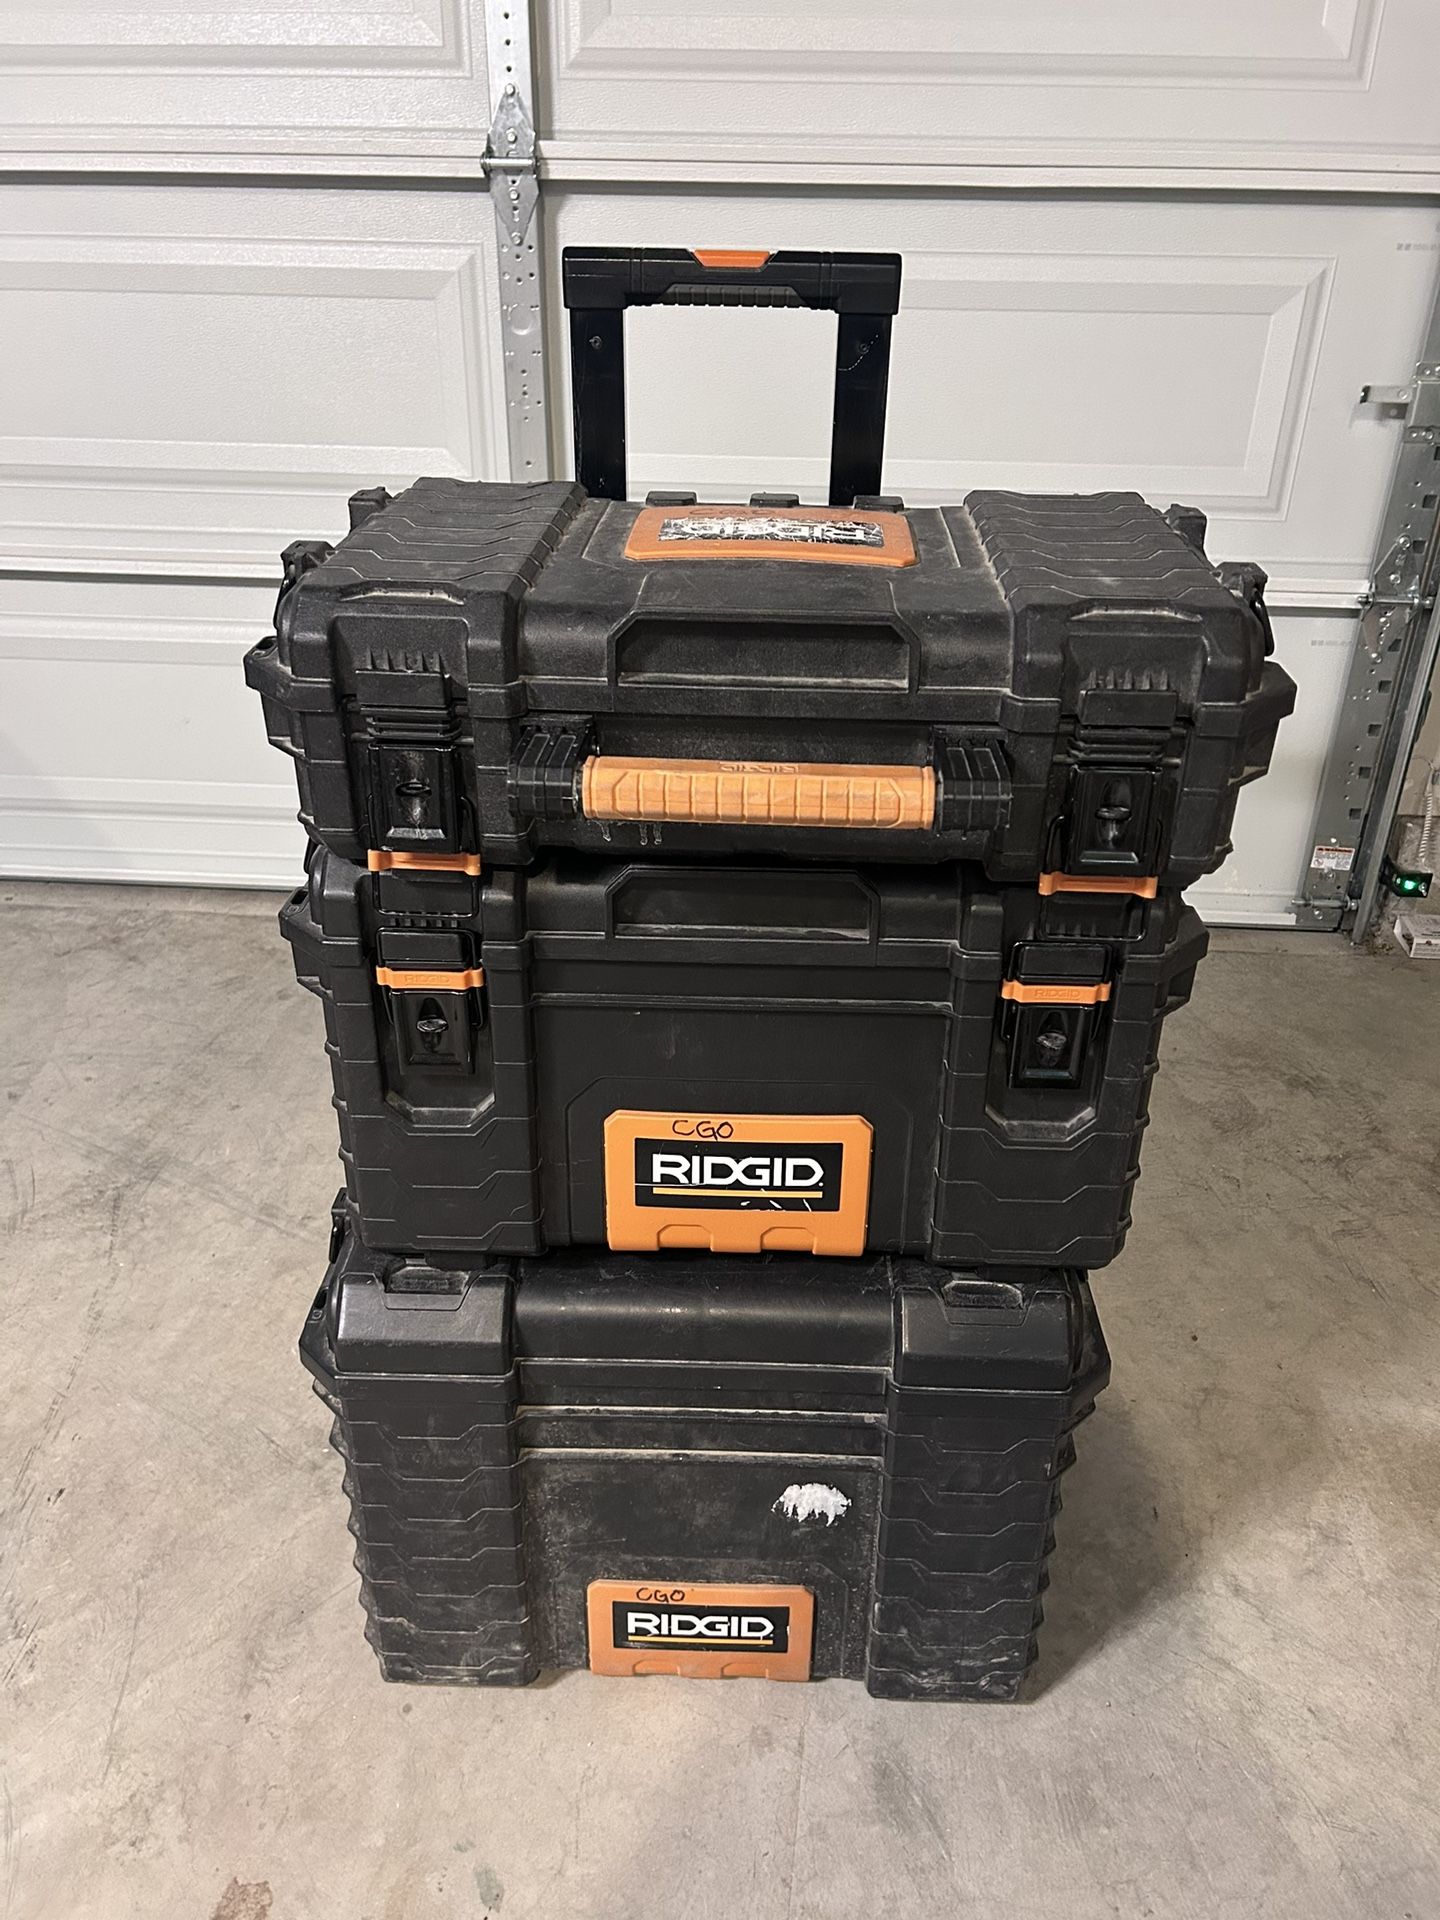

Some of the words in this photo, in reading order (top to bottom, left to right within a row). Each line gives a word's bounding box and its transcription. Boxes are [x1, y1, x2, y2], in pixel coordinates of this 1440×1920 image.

[671, 1119, 734, 1142] CGO
[651, 1152, 825, 1188] RIDGID
[635, 1587, 686, 1603] CGO
[626, 1611, 775, 1638] RIDGID
